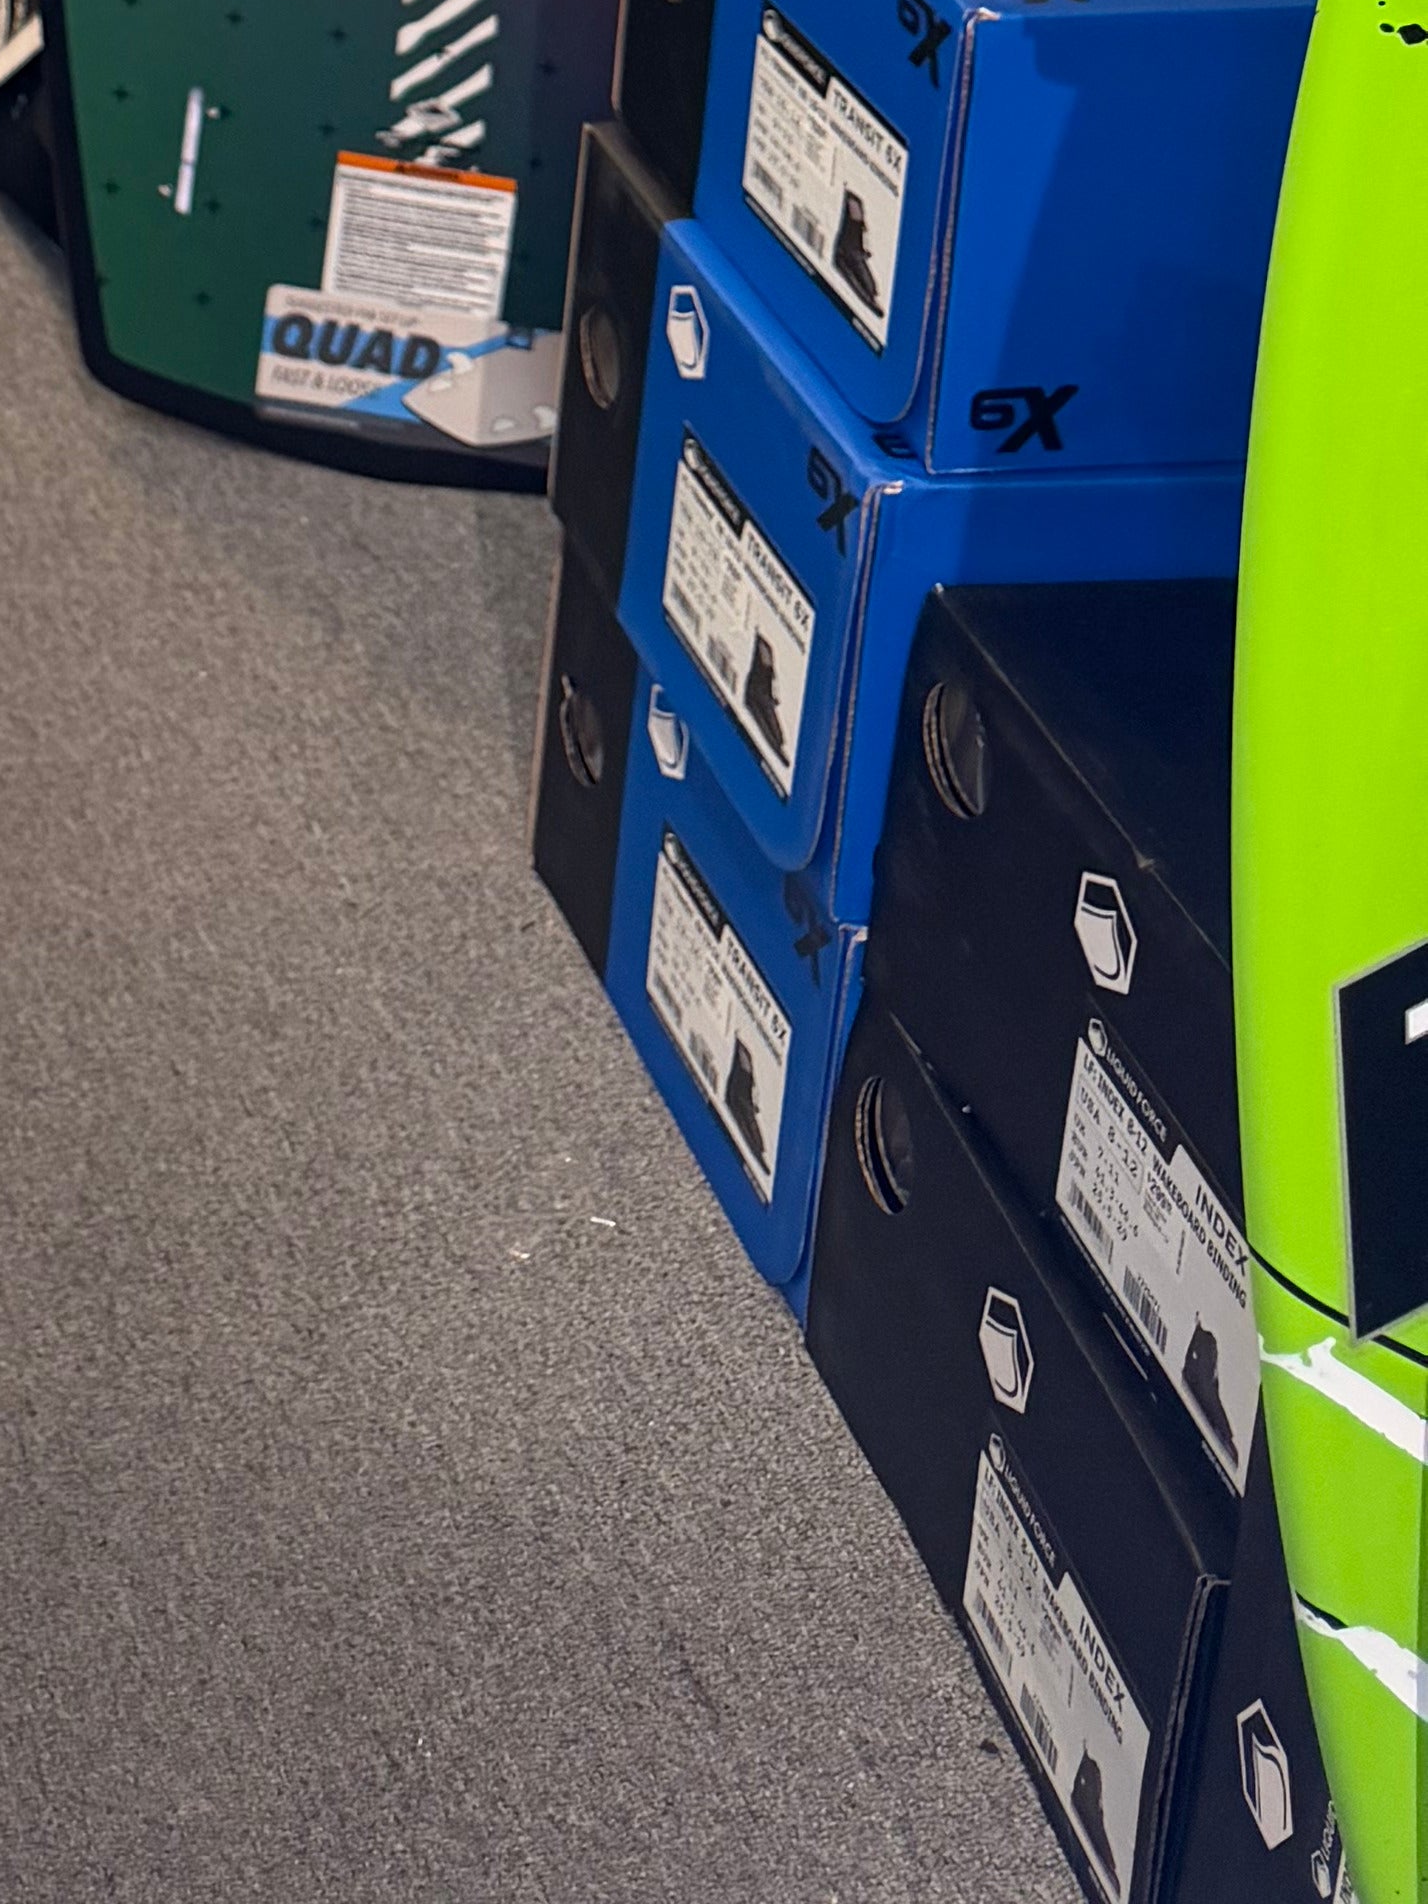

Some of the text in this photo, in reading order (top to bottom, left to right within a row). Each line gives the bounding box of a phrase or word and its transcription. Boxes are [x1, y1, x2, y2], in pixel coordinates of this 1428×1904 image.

[832, 85, 883, 156] TRANSIT
[272, 312, 441, 379] QUAD
[969, 385, 1078, 453] 6X
[807, 445, 859, 558] 6X
[746, 529, 793, 608] TRANSIT
[725, 934, 771, 1023] TRANSIT
[1080, 1084, 1100, 1127] USA
[1152, 1151, 1206, 1250] WAKEBOARD
[1206, 1234, 1246, 1312] BINDING
[1194, 1183, 1251, 1276] INDEX
[1079, 1616, 1125, 1713] INDEX
